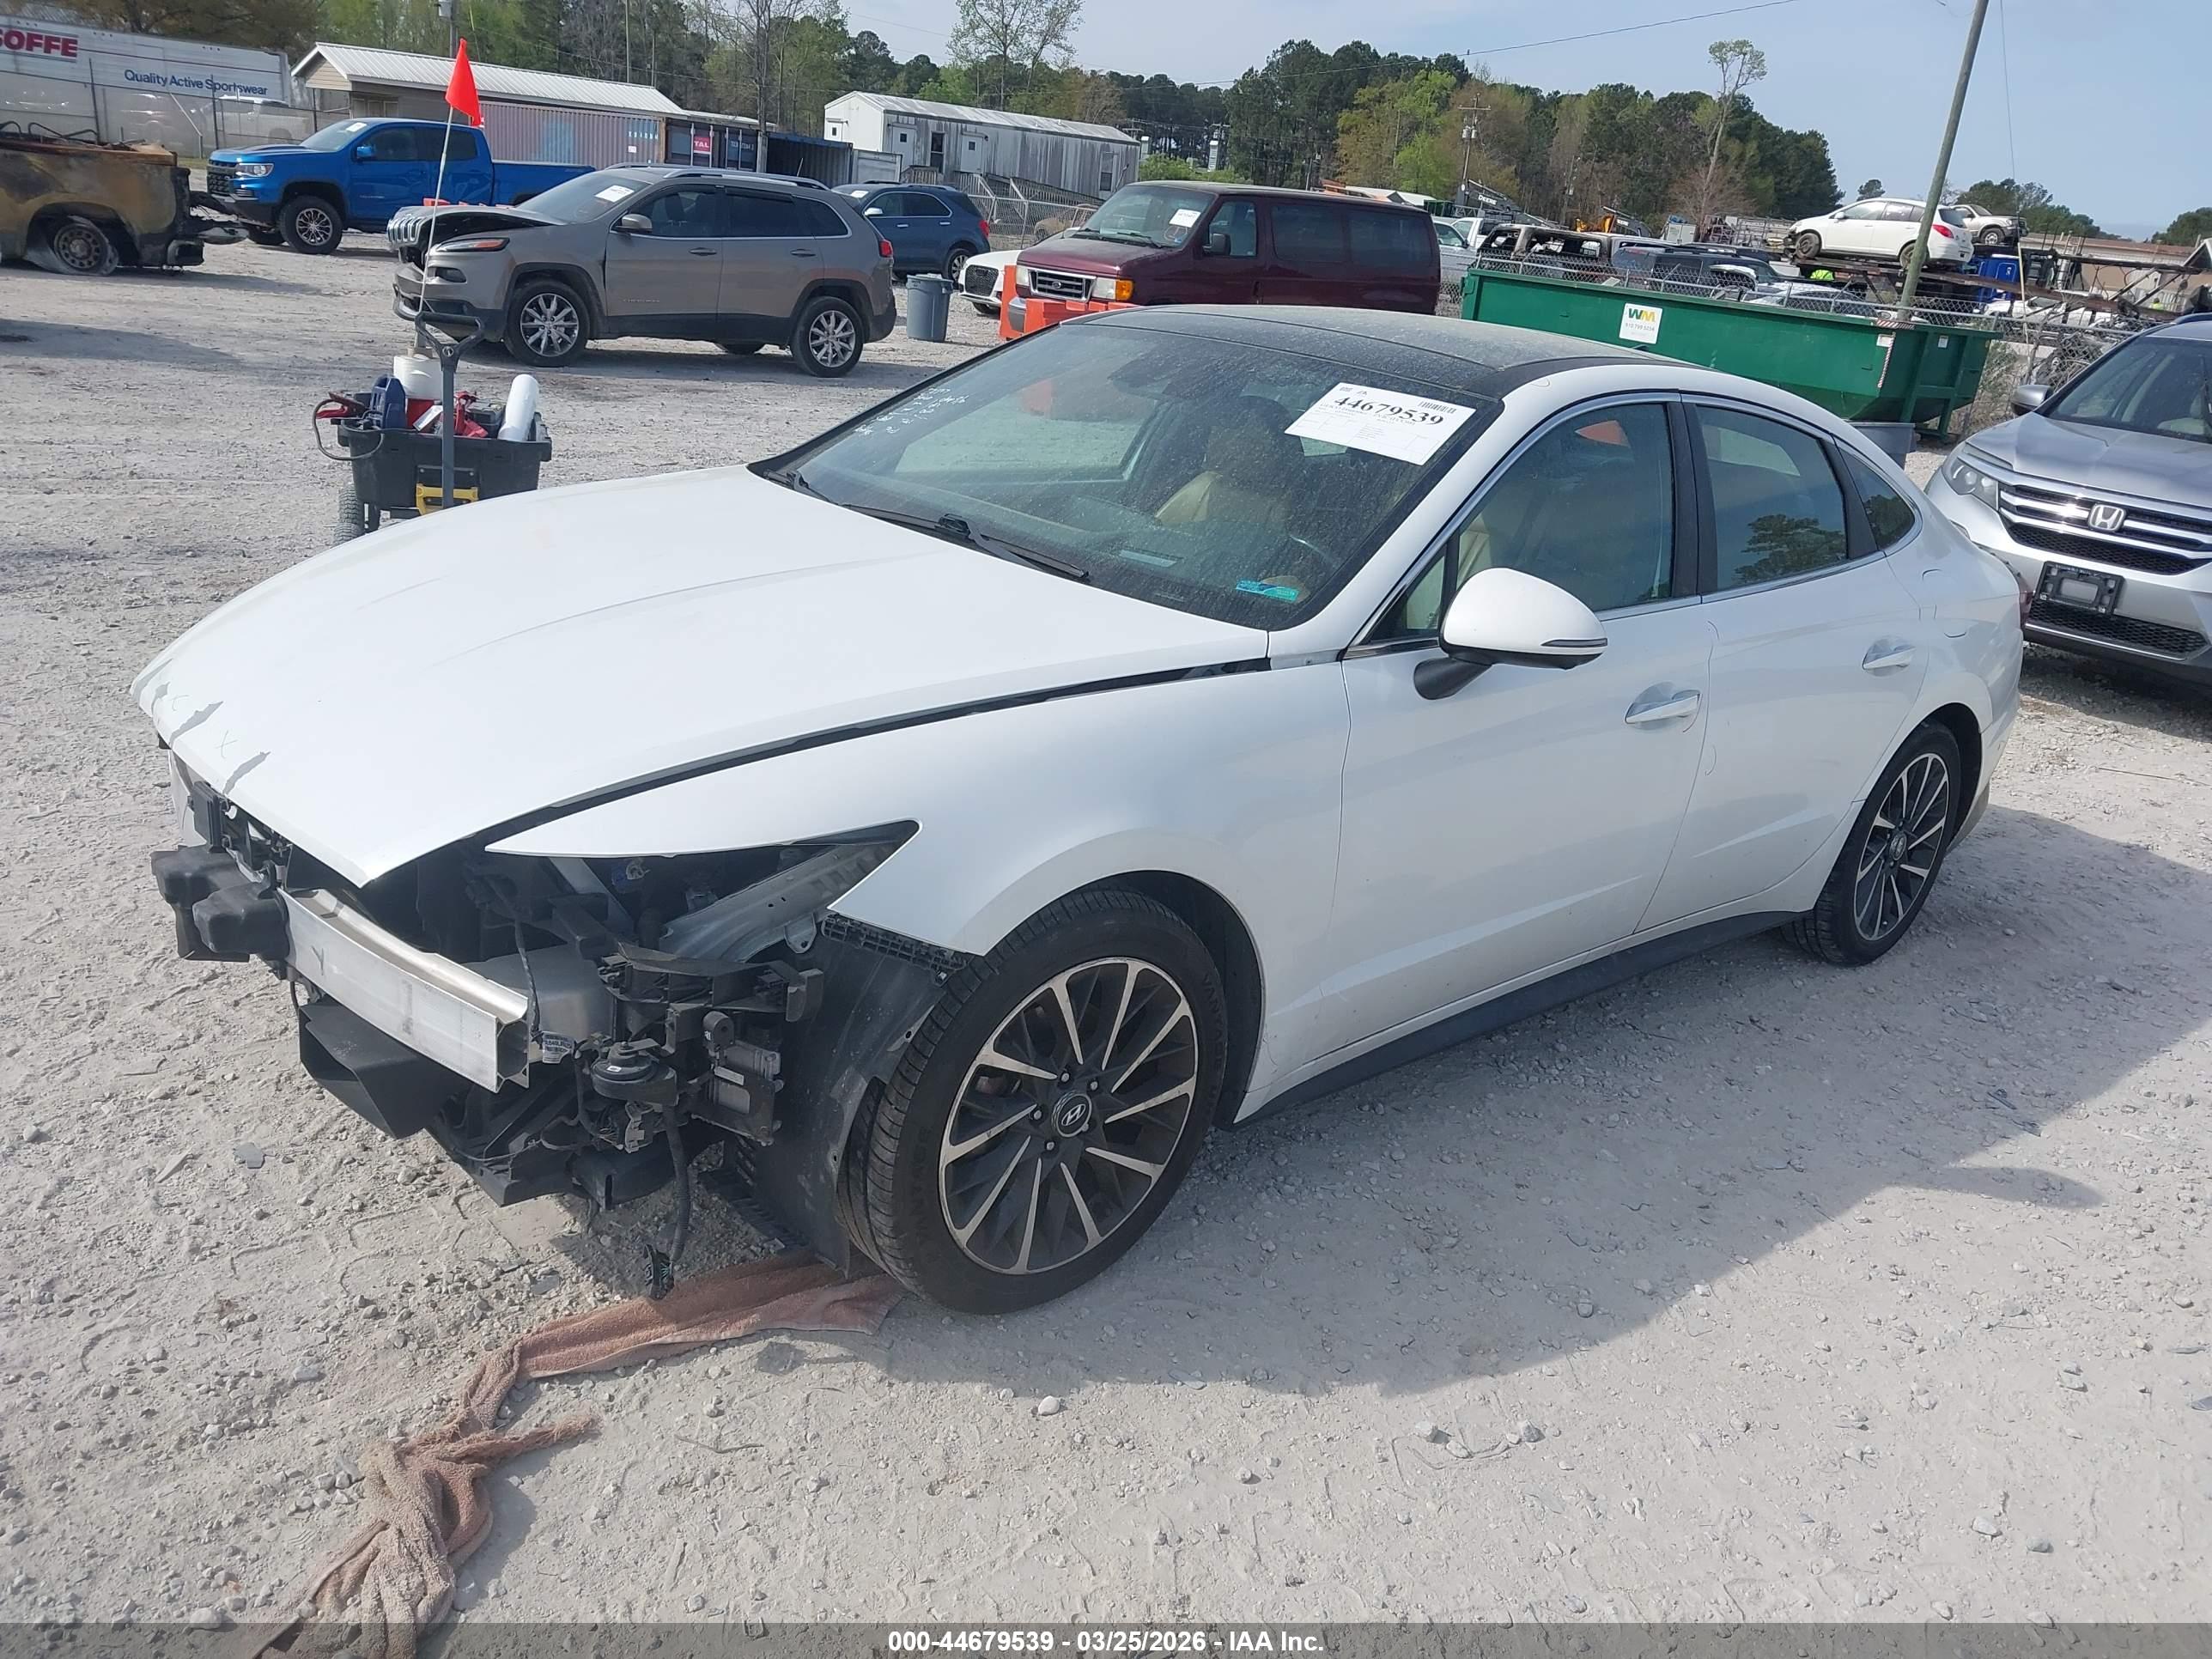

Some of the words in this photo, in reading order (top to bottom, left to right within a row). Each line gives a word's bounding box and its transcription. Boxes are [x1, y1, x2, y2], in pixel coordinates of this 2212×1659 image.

[0, 27, 78, 57] OFFE
[124, 70, 167, 87] Quality
[169, 76, 204, 89] Active
[204, 78, 268, 95] Sportswear
[693, 140, 710, 149] TAL
[1628, 308, 1656, 323] WM
[1335, 397, 1443, 425] 44679539
